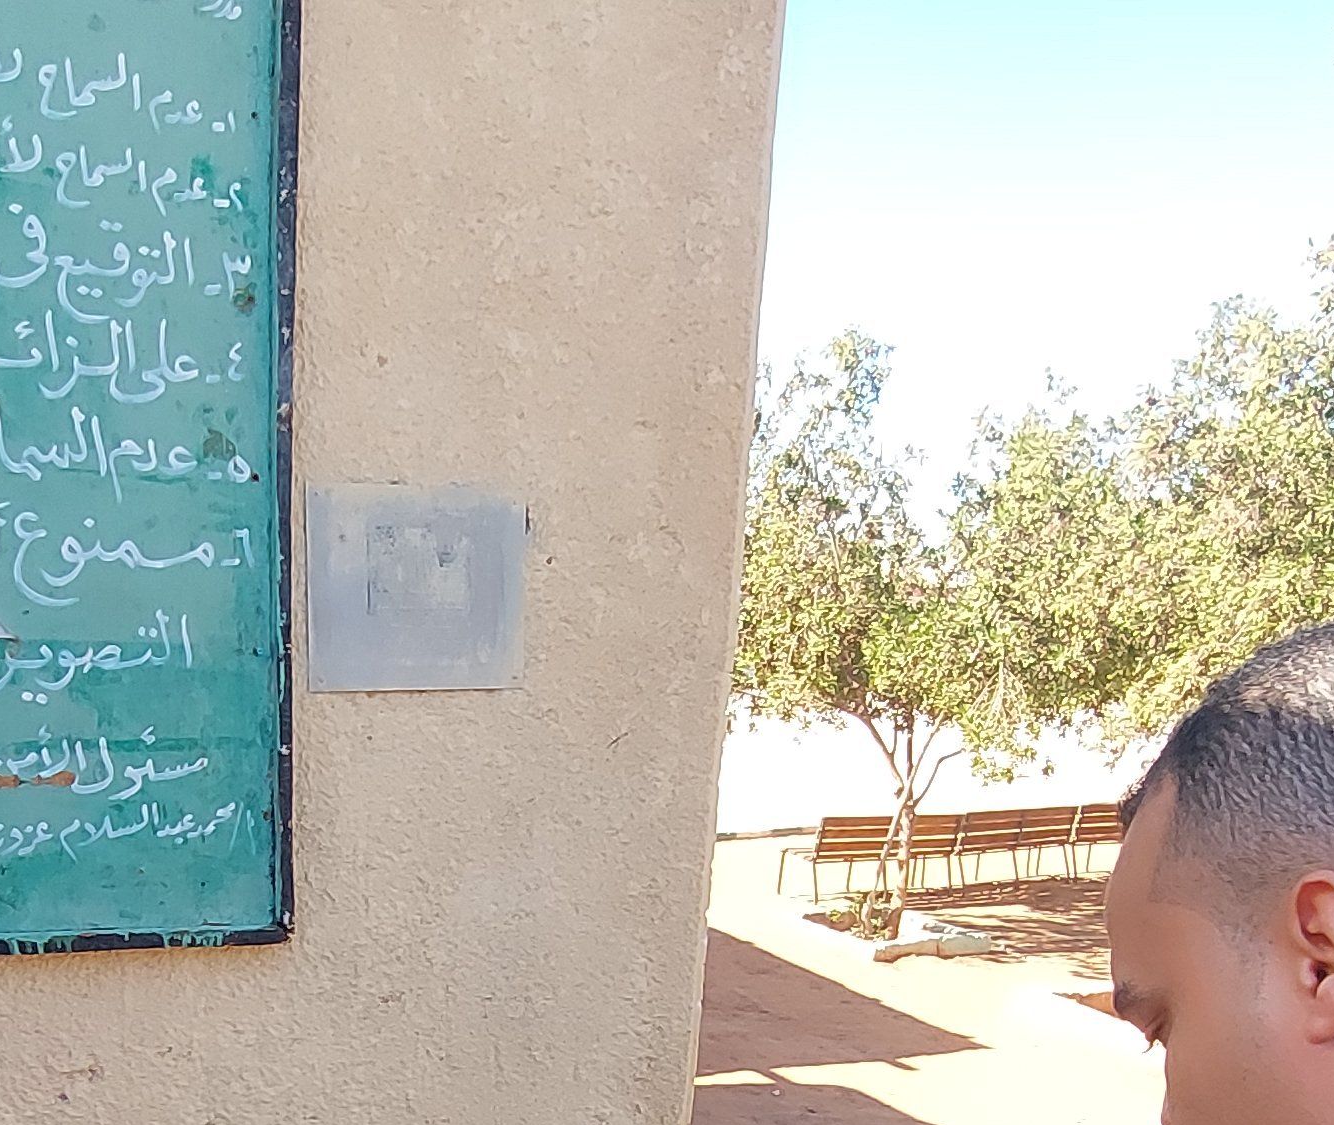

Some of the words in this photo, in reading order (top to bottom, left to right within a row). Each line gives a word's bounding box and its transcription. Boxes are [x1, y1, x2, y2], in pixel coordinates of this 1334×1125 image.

[38, 53, 142, 120] السماح
[149, 90, 204, 134] عدم
[54, 145, 148, 208] السماح
[151, 167, 208, 218] عدم
[53, 219, 196, 324] التوقيع
[109, 318, 199, 402] على
[108, 437, 198, 504] عدم
[13, 511, 215, 606] ممنوع
